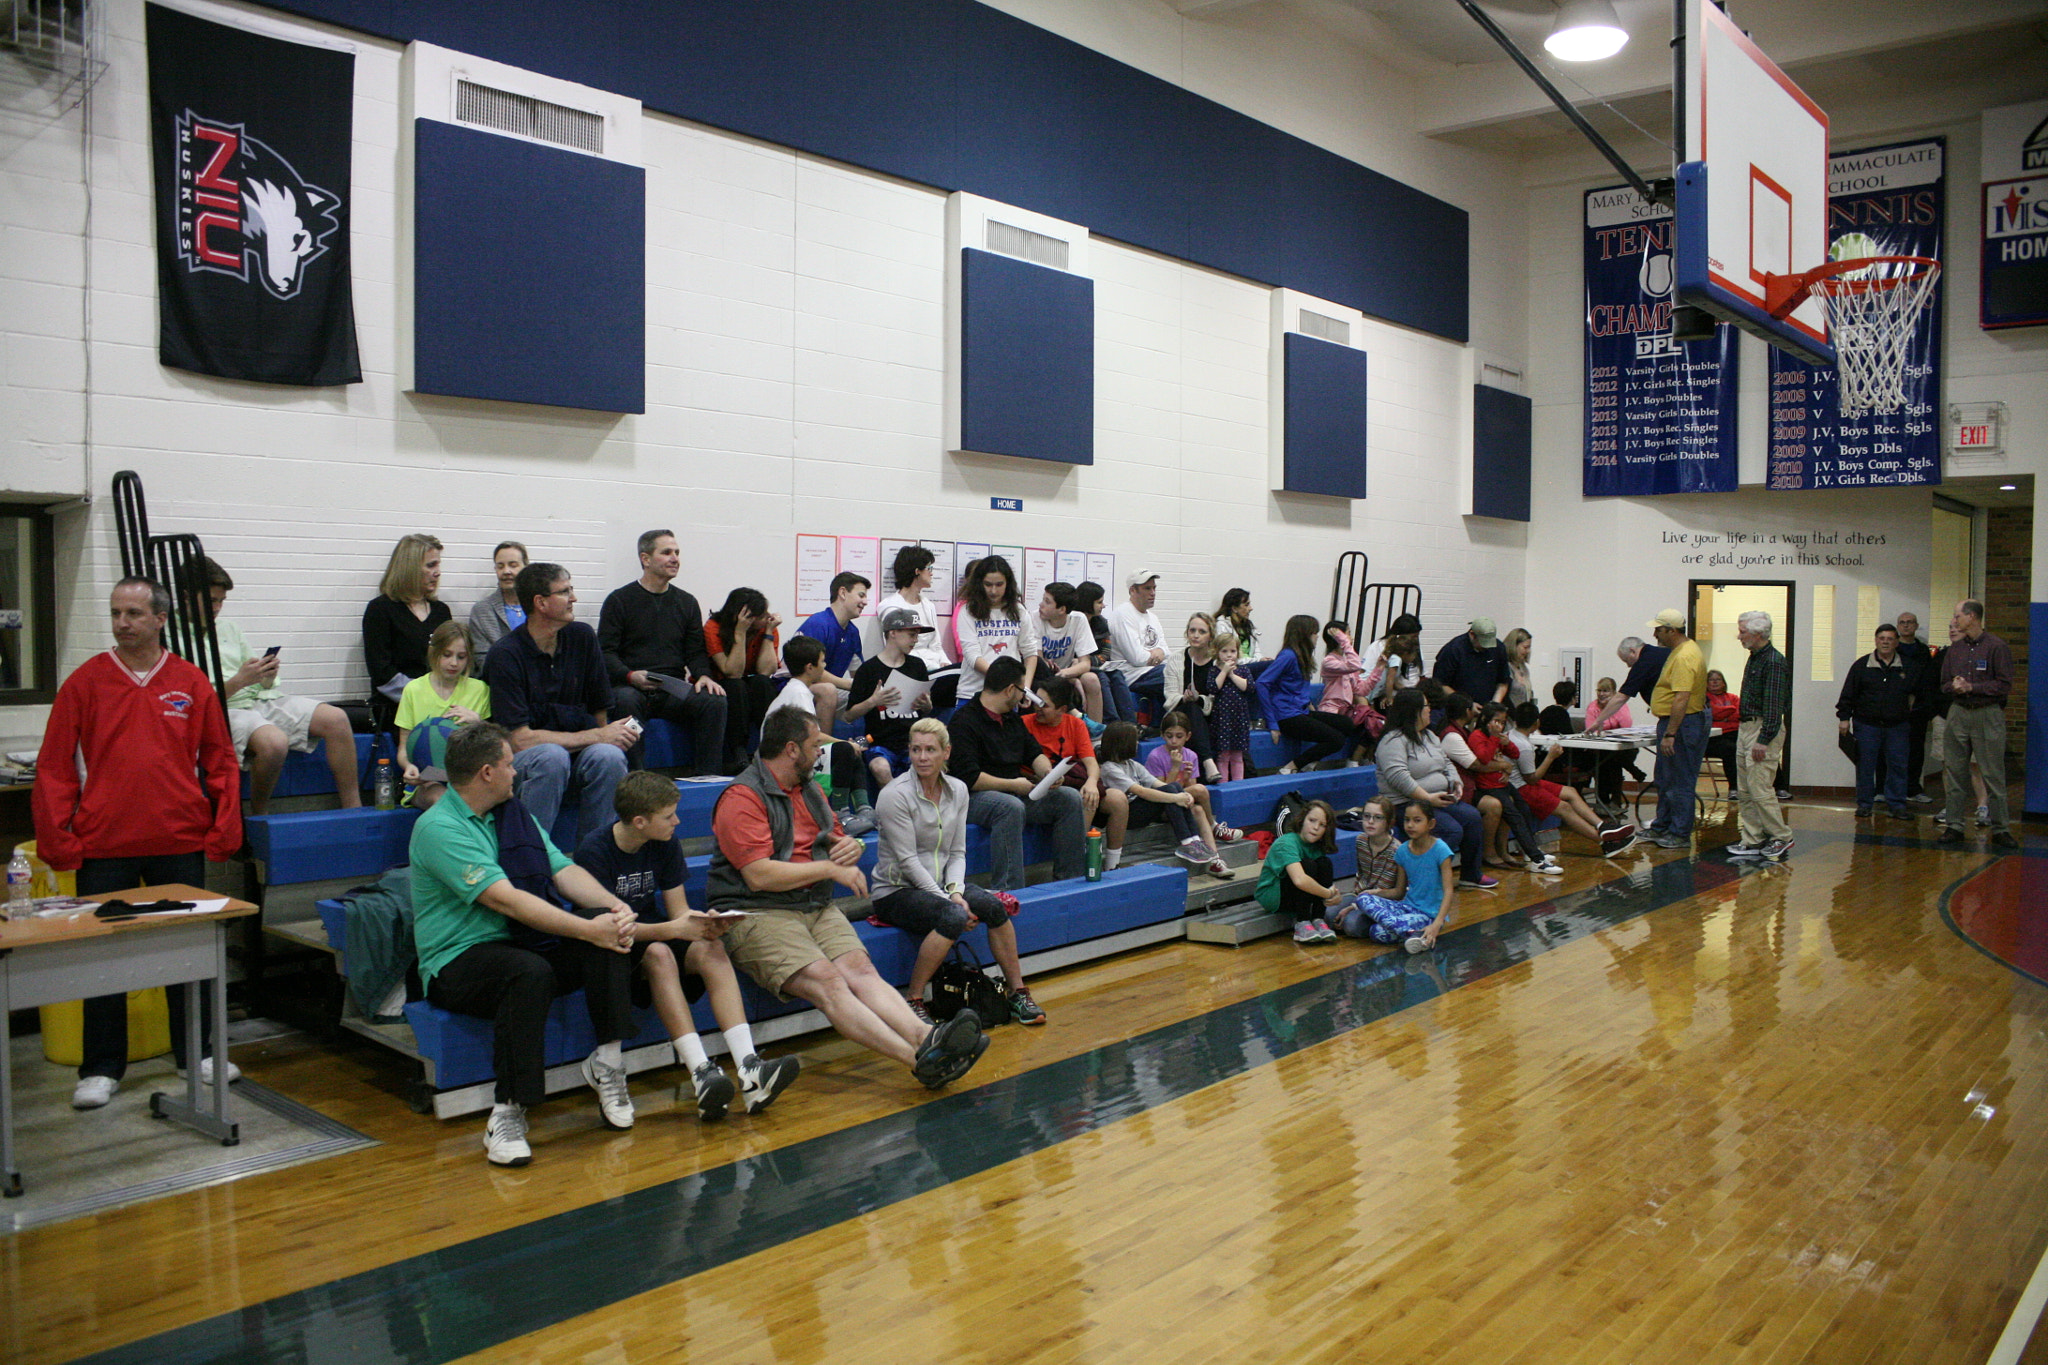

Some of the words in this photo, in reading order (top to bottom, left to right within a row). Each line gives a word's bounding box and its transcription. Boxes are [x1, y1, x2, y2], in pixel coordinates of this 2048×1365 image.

[181, 129, 192, 250] HUSKIES
[1828, 175, 1888, 194] CHOOL
[195, 123, 242, 269] NIU
[1592, 193, 1633, 209] MARY
[1631, 203, 1673, 219] SCHO
[1829, 191, 1936, 229] NNIS
[1596, 221, 1674, 260] TEN
[2002, 238, 2048, 262] HOM
[1590, 301, 1674, 337] CHAMP
[1592, 366, 1618, 378] 2012
[1625, 367, 1656, 376] Varsity
[1659, 364, 1679, 373] Girls
[1681, 361, 1720, 372] Doubles
[1773, 371, 1806, 385] 2006
[1813, 371, 1836, 385] J.V.
[1905, 364, 1933, 378] Sgls
[1592, 381, 1618, 393] 2012
[1625, 383, 1642, 393] J.V.
[1643, 379, 1666, 390] Girls
[1666, 377, 1684, 387] Rec.
[1686, 376, 1721, 388] Singles
[1592, 396, 1618, 408] 2012
[1625, 397, 1642, 408] J.V.
[1643, 395, 1665, 405] Boys
[1665, 392, 1703, 403] Doubles
[1813, 390, 1824, 401] V
[1591, 410, 1618, 423] 2013
[1625, 411, 1657, 421] Varsity
[1658, 409, 1678, 418] Girls
[1679, 406, 1720, 417] Doubles
[1812, 408, 1824, 420] V
[1904, 402, 1932, 417] Sgls
[1591, 424, 1618, 438] 2013
[1625, 426, 1642, 438] J.V.
[1643, 424, 1665, 436] Boys
[1665, 423, 1682, 433] Rec.
[1683, 421, 1719, 434] Singles
[1772, 426, 1806, 440] 2009
[1812, 427, 1835, 441] J.V.
[1839, 425, 1869, 440] Boys
[1873, 423, 1900, 435] Rec.
[1904, 421, 1933, 437] Sgls
[1960, 425, 1989, 446] EXIT
[1591, 439, 1618, 452] 2014
[1625, 439, 1642, 450] J.V.
[1644, 437, 1665, 449] Boys
[1681, 434, 1719, 446] Singles
[1772, 444, 1806, 458] 2009
[1813, 446, 1823, 457] V
[1839, 443, 1869, 458] Boys
[1873, 442, 1902, 454] Dbls
[1591, 454, 1618, 467] 2014
[1625, 454, 1657, 464] Varsity
[1658, 451, 1678, 461] Girls
[1679, 449, 1720, 460] Doubles
[1771, 461, 1803, 475] 2010
[1814, 461, 1834, 475] J.V.
[1838, 460, 1864, 474] Boys
[1867, 458, 1903, 472] Comp.
[1907, 456, 1934, 470] Sgls.
[1814, 475, 1834, 488] J.V.
[1838, 474, 1866, 486] Girls
[1869, 473, 1894, 484] Rec.
[1898, 471, 1927, 484] Dbls.
[997, 500, 1017, 509] HOME
[1662, 531, 1688, 544] Live
[1691, 534, 1720, 549] your
[1726, 531, 1747, 549] life
[1752, 531, 1764, 544] in
[1769, 535, 1776, 544] a
[1782, 533, 1807, 549] way
[1812, 531, 1838, 545] that
[1845, 532, 1886, 546] others
[1681, 553, 1704, 564] are
[1709, 552, 1733, 567] glad
[1781, 553, 1793, 565] in
[1797, 551, 1820, 565] this
[975, 619, 1021, 629] MUSTAN
